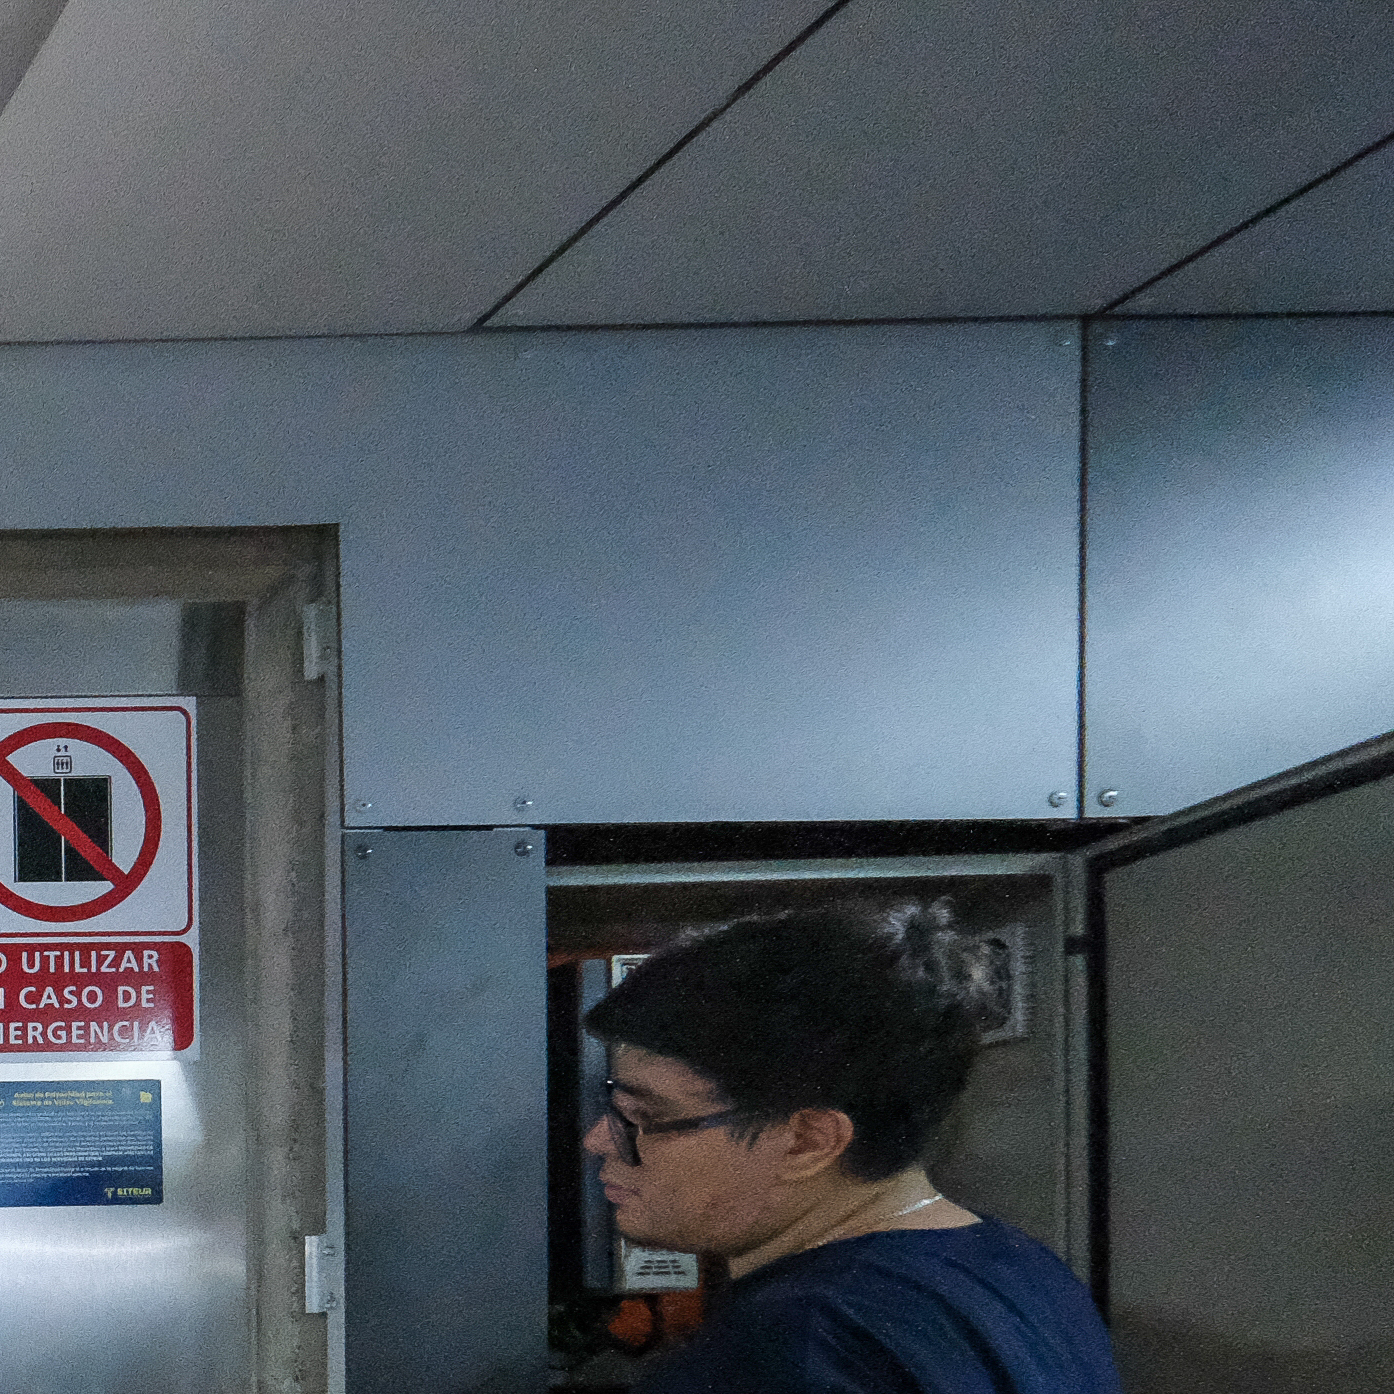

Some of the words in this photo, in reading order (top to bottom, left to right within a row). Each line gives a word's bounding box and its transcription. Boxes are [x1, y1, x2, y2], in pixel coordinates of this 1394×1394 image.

[21, 950, 160, 973] UTILIZAR
[18, 986, 104, 1009] CASO
[117, 985, 155, 1008] DE
